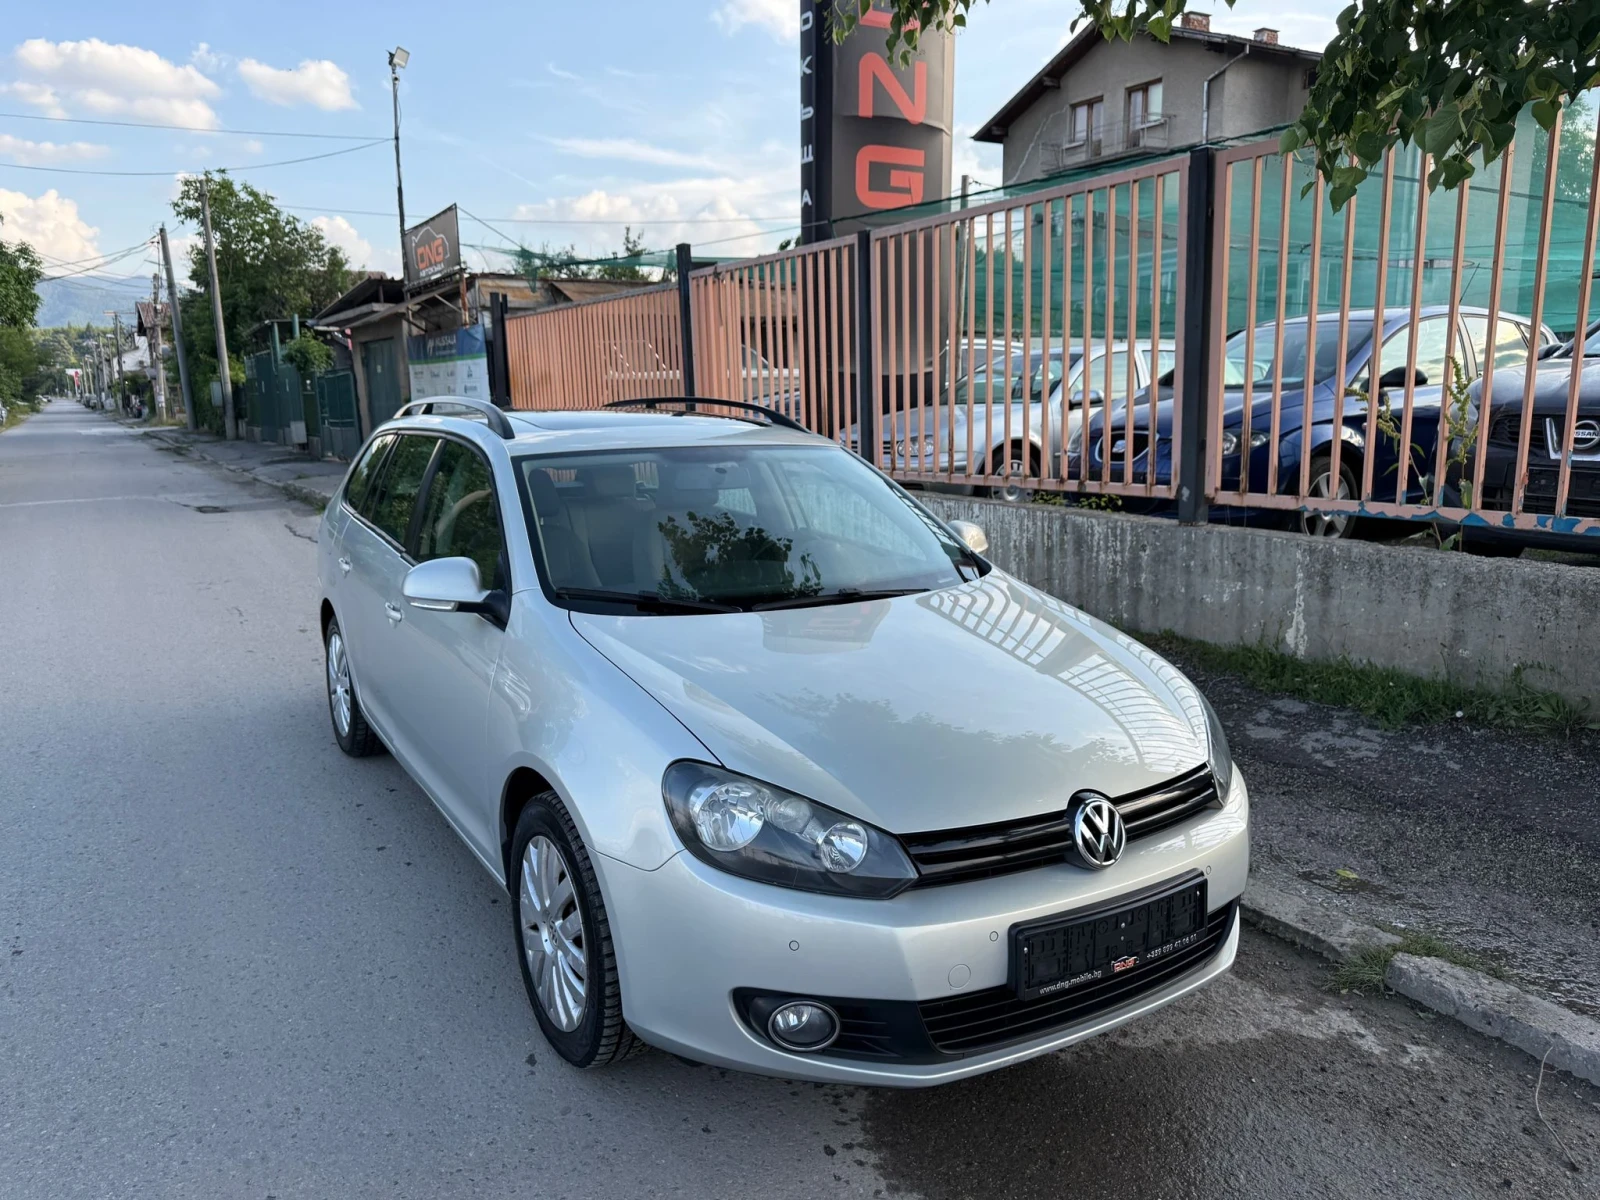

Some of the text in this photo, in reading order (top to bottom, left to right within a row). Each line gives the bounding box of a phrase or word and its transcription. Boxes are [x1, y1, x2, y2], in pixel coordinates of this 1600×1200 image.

[855, 0, 927, 208] NG
[416, 237, 444, 270] DNG
[1039, 970, 1102, 994] www.dng.mobile.bg
